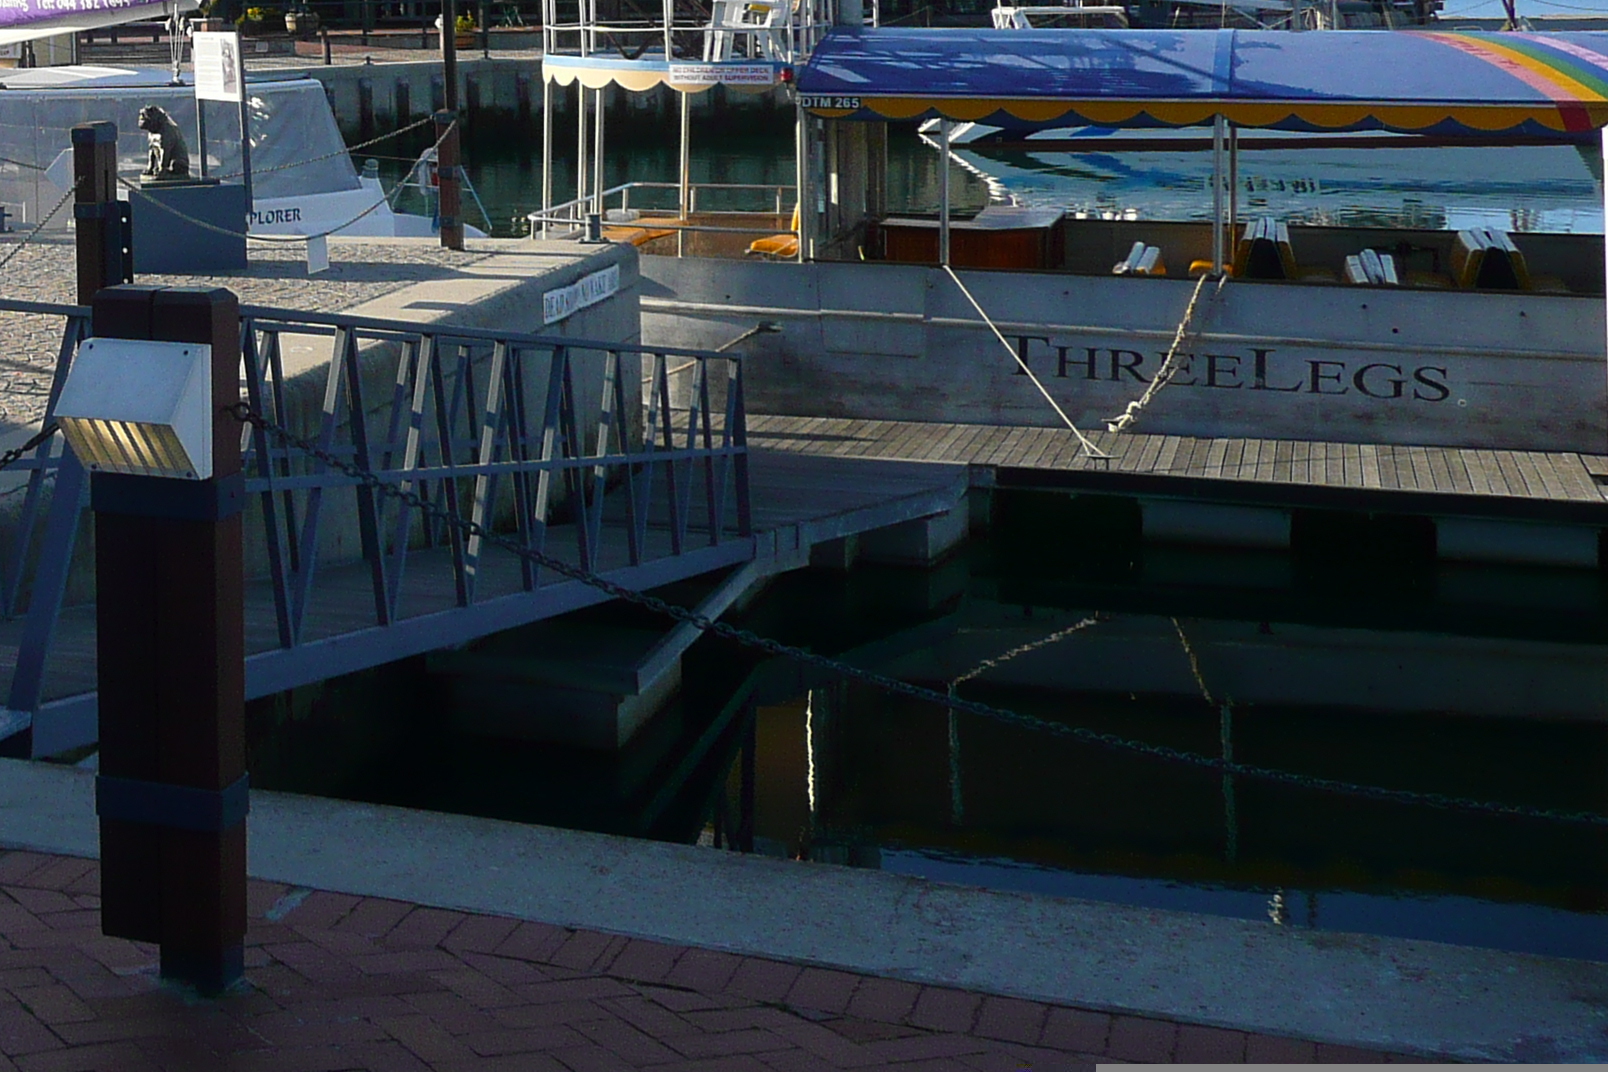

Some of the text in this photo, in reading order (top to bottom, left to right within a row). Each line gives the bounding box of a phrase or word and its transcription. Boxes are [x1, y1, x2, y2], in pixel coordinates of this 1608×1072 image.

[802, 97, 860, 108] DTM 265
[249, 208, 302, 225] PLORER
